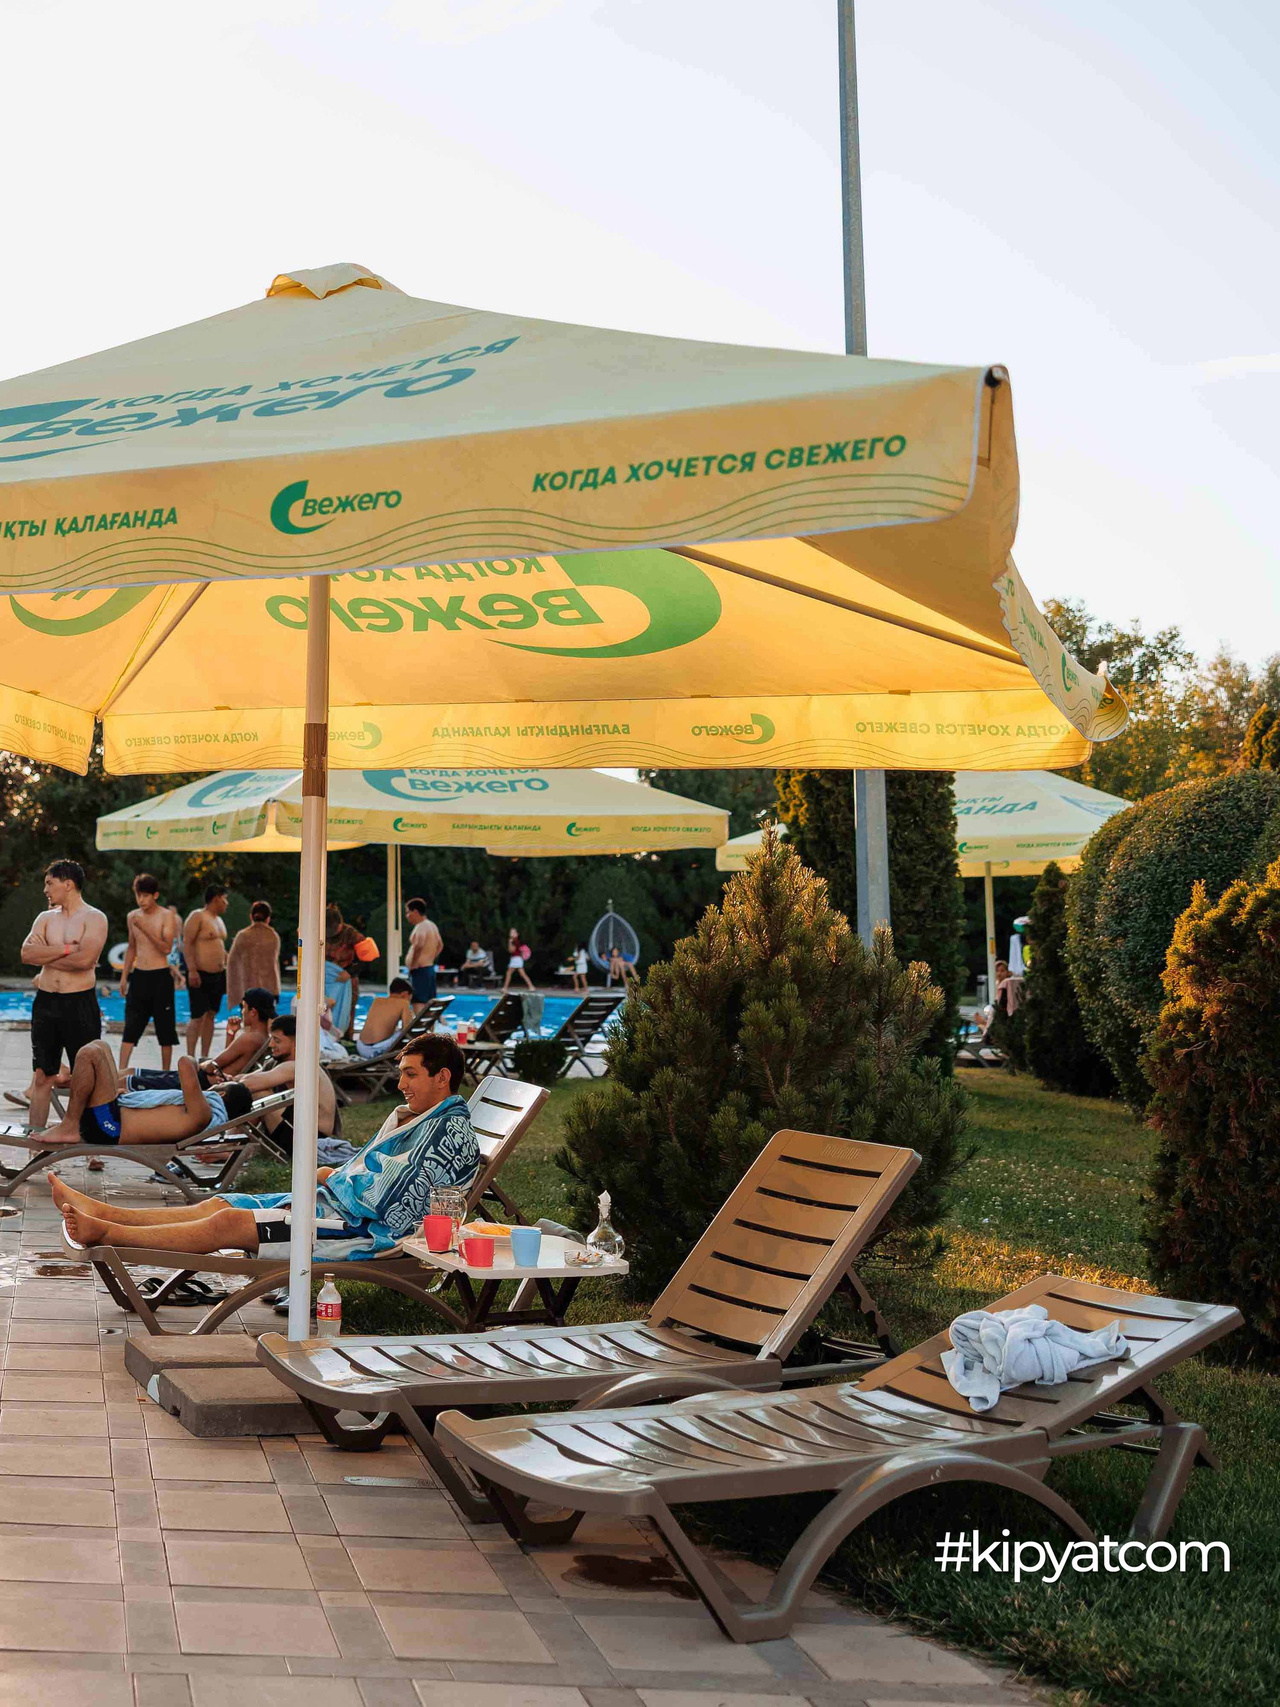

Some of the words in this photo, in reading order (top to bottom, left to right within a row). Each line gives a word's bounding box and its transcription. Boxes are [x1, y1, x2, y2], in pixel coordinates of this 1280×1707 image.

[91, 384, 253, 411] КОГДА
[260, 335, 522, 394] ХОЧЕТСЯ
[531, 464, 618, 493] КОГДА
[624, 450, 758, 483] ХОЧЕТСЯ
[764, 434, 908, 472] СВЕЖЕГО
[54, 506, 178, 538] ҚАЛАҒАНДА
[269, 478, 403, 536] Свежего
